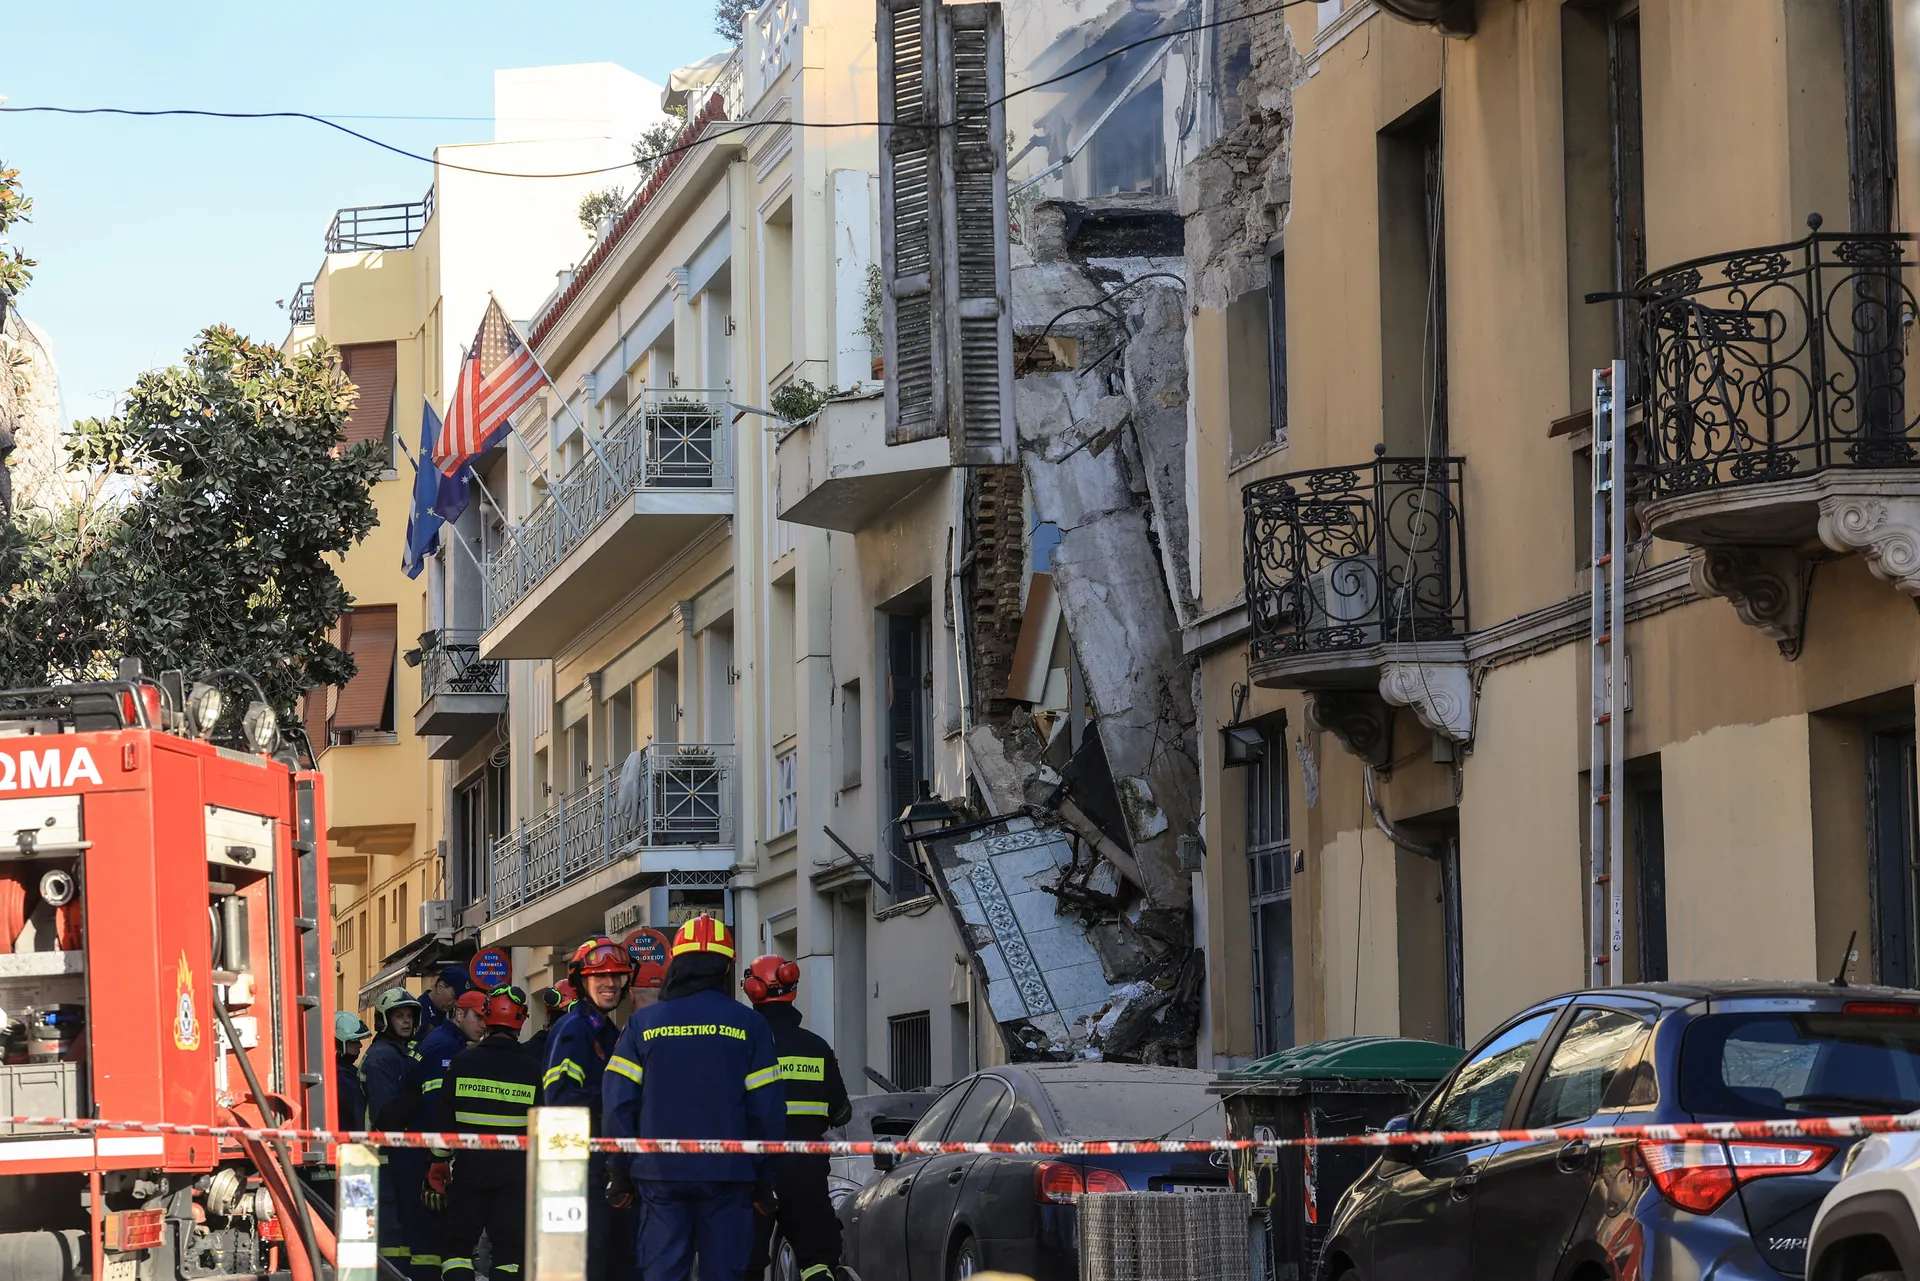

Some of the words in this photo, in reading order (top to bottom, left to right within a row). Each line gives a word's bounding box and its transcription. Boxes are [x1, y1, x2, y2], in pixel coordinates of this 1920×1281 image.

[642, 1024, 717, 1042] ΠΥΡΟΣΒΕΣΤΙΚΟ
[718, 1024, 747, 1041] ΣΩΜΑ
[796, 1064, 820, 1074] ΣΩΜΑ
[458, 1083, 510, 1096] ΠΥΡΟΣΒΕΣΤΙΚΟ
[511, 1089, 531, 1099] ΣΩΜΑ
[1768, 1237, 1808, 1250] YARI
